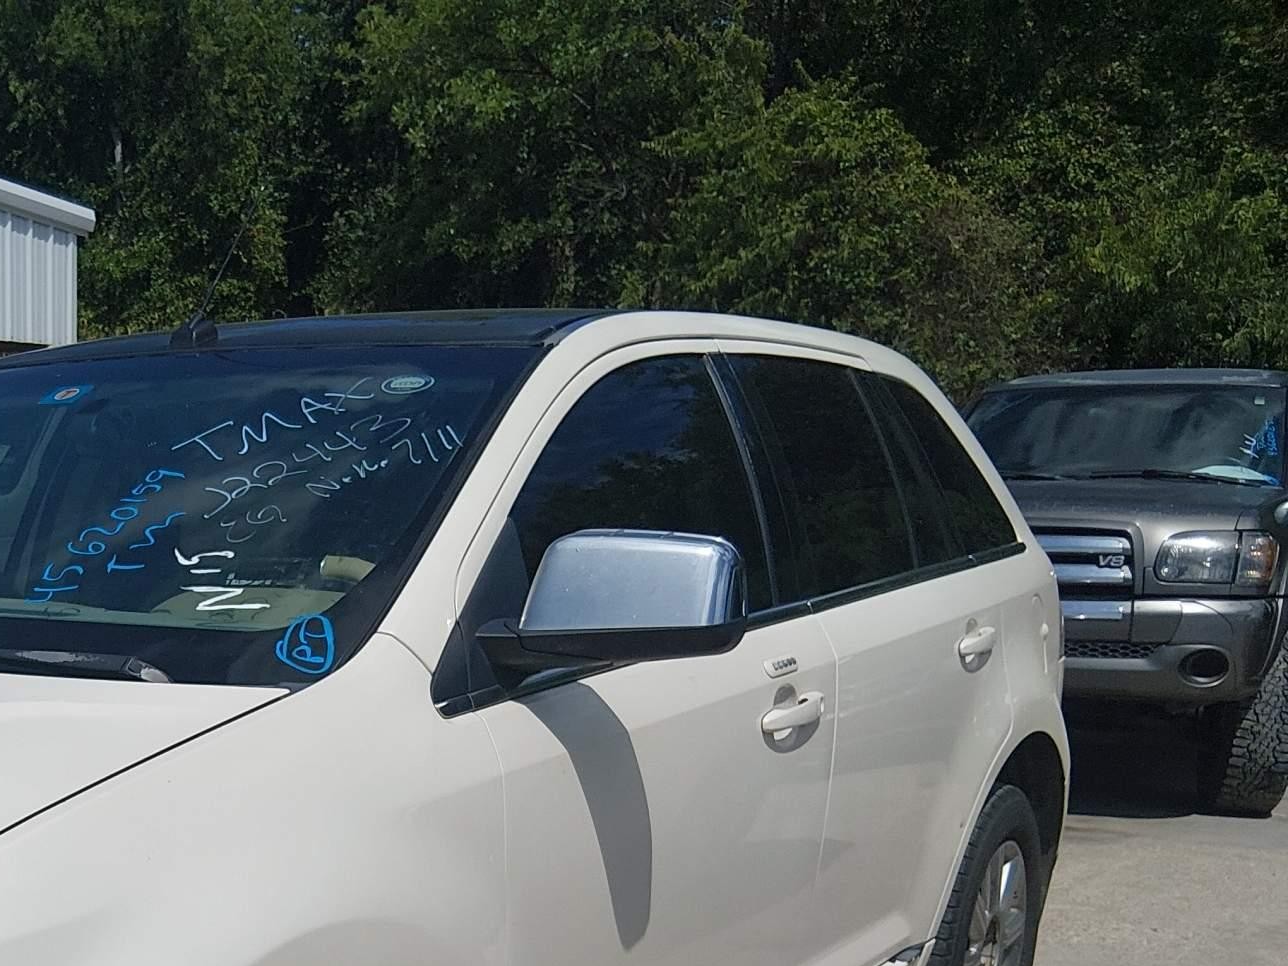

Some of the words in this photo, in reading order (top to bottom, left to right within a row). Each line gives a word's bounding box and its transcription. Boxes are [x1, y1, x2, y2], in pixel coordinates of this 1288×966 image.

[171, 376, 375, 461] TMAX
[23, 468, 186, 604] 45620159
[1098, 555, 1125, 566] V8
